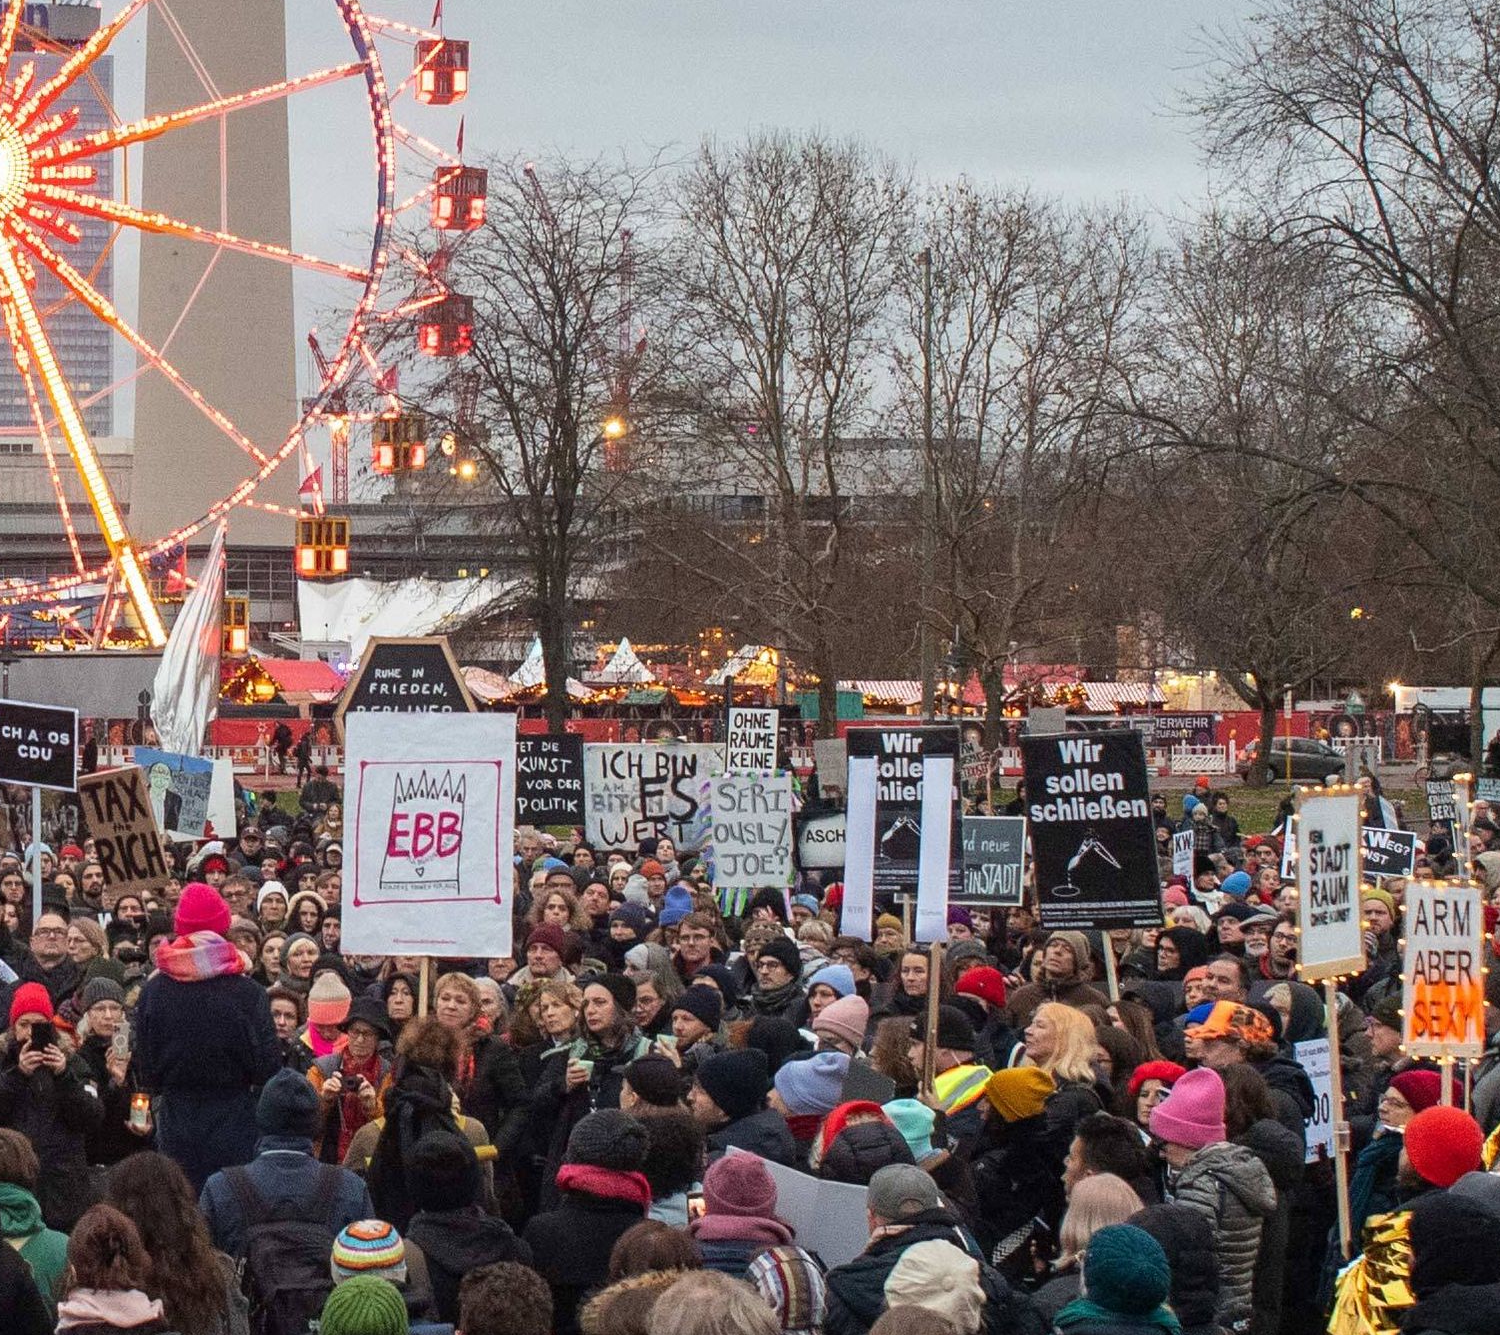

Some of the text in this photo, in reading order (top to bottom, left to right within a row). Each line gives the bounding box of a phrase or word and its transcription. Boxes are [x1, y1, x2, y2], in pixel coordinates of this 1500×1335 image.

[374, 667, 424, 678] RUHE IN
[370, 683, 448, 697] FRIEDEN,
[734, 712, 771, 729] OHNE
[17, 744, 53, 761] CDU
[730, 731, 775, 751] RÄUME
[881, 733, 923, 754] Wir
[1058, 739, 1103, 764] Wir
[516, 755, 573, 774] KUNST
[602, 750, 697, 779] ICH BIN
[730, 752, 772, 769] KEINE
[876, 758, 923, 778] olle
[526, 779, 582, 790] VOR DER
[1045, 769, 1125, 794] sollen
[79, 773, 147, 825] TAX
[517, 797, 578, 813] POLITIK
[1030, 795, 1149, 822] schließen
[386, 811, 462, 859] EBB
[600, 817, 694, 846] WERT
[95, 831, 169, 885] RICH
[720, 846, 790, 877] JOE?
[1309, 843, 1351, 875] STADT
[1310, 875, 1350, 908] RAUM
[1414, 899, 1471, 937] ARM
[1412, 950, 1473, 985] ABER
